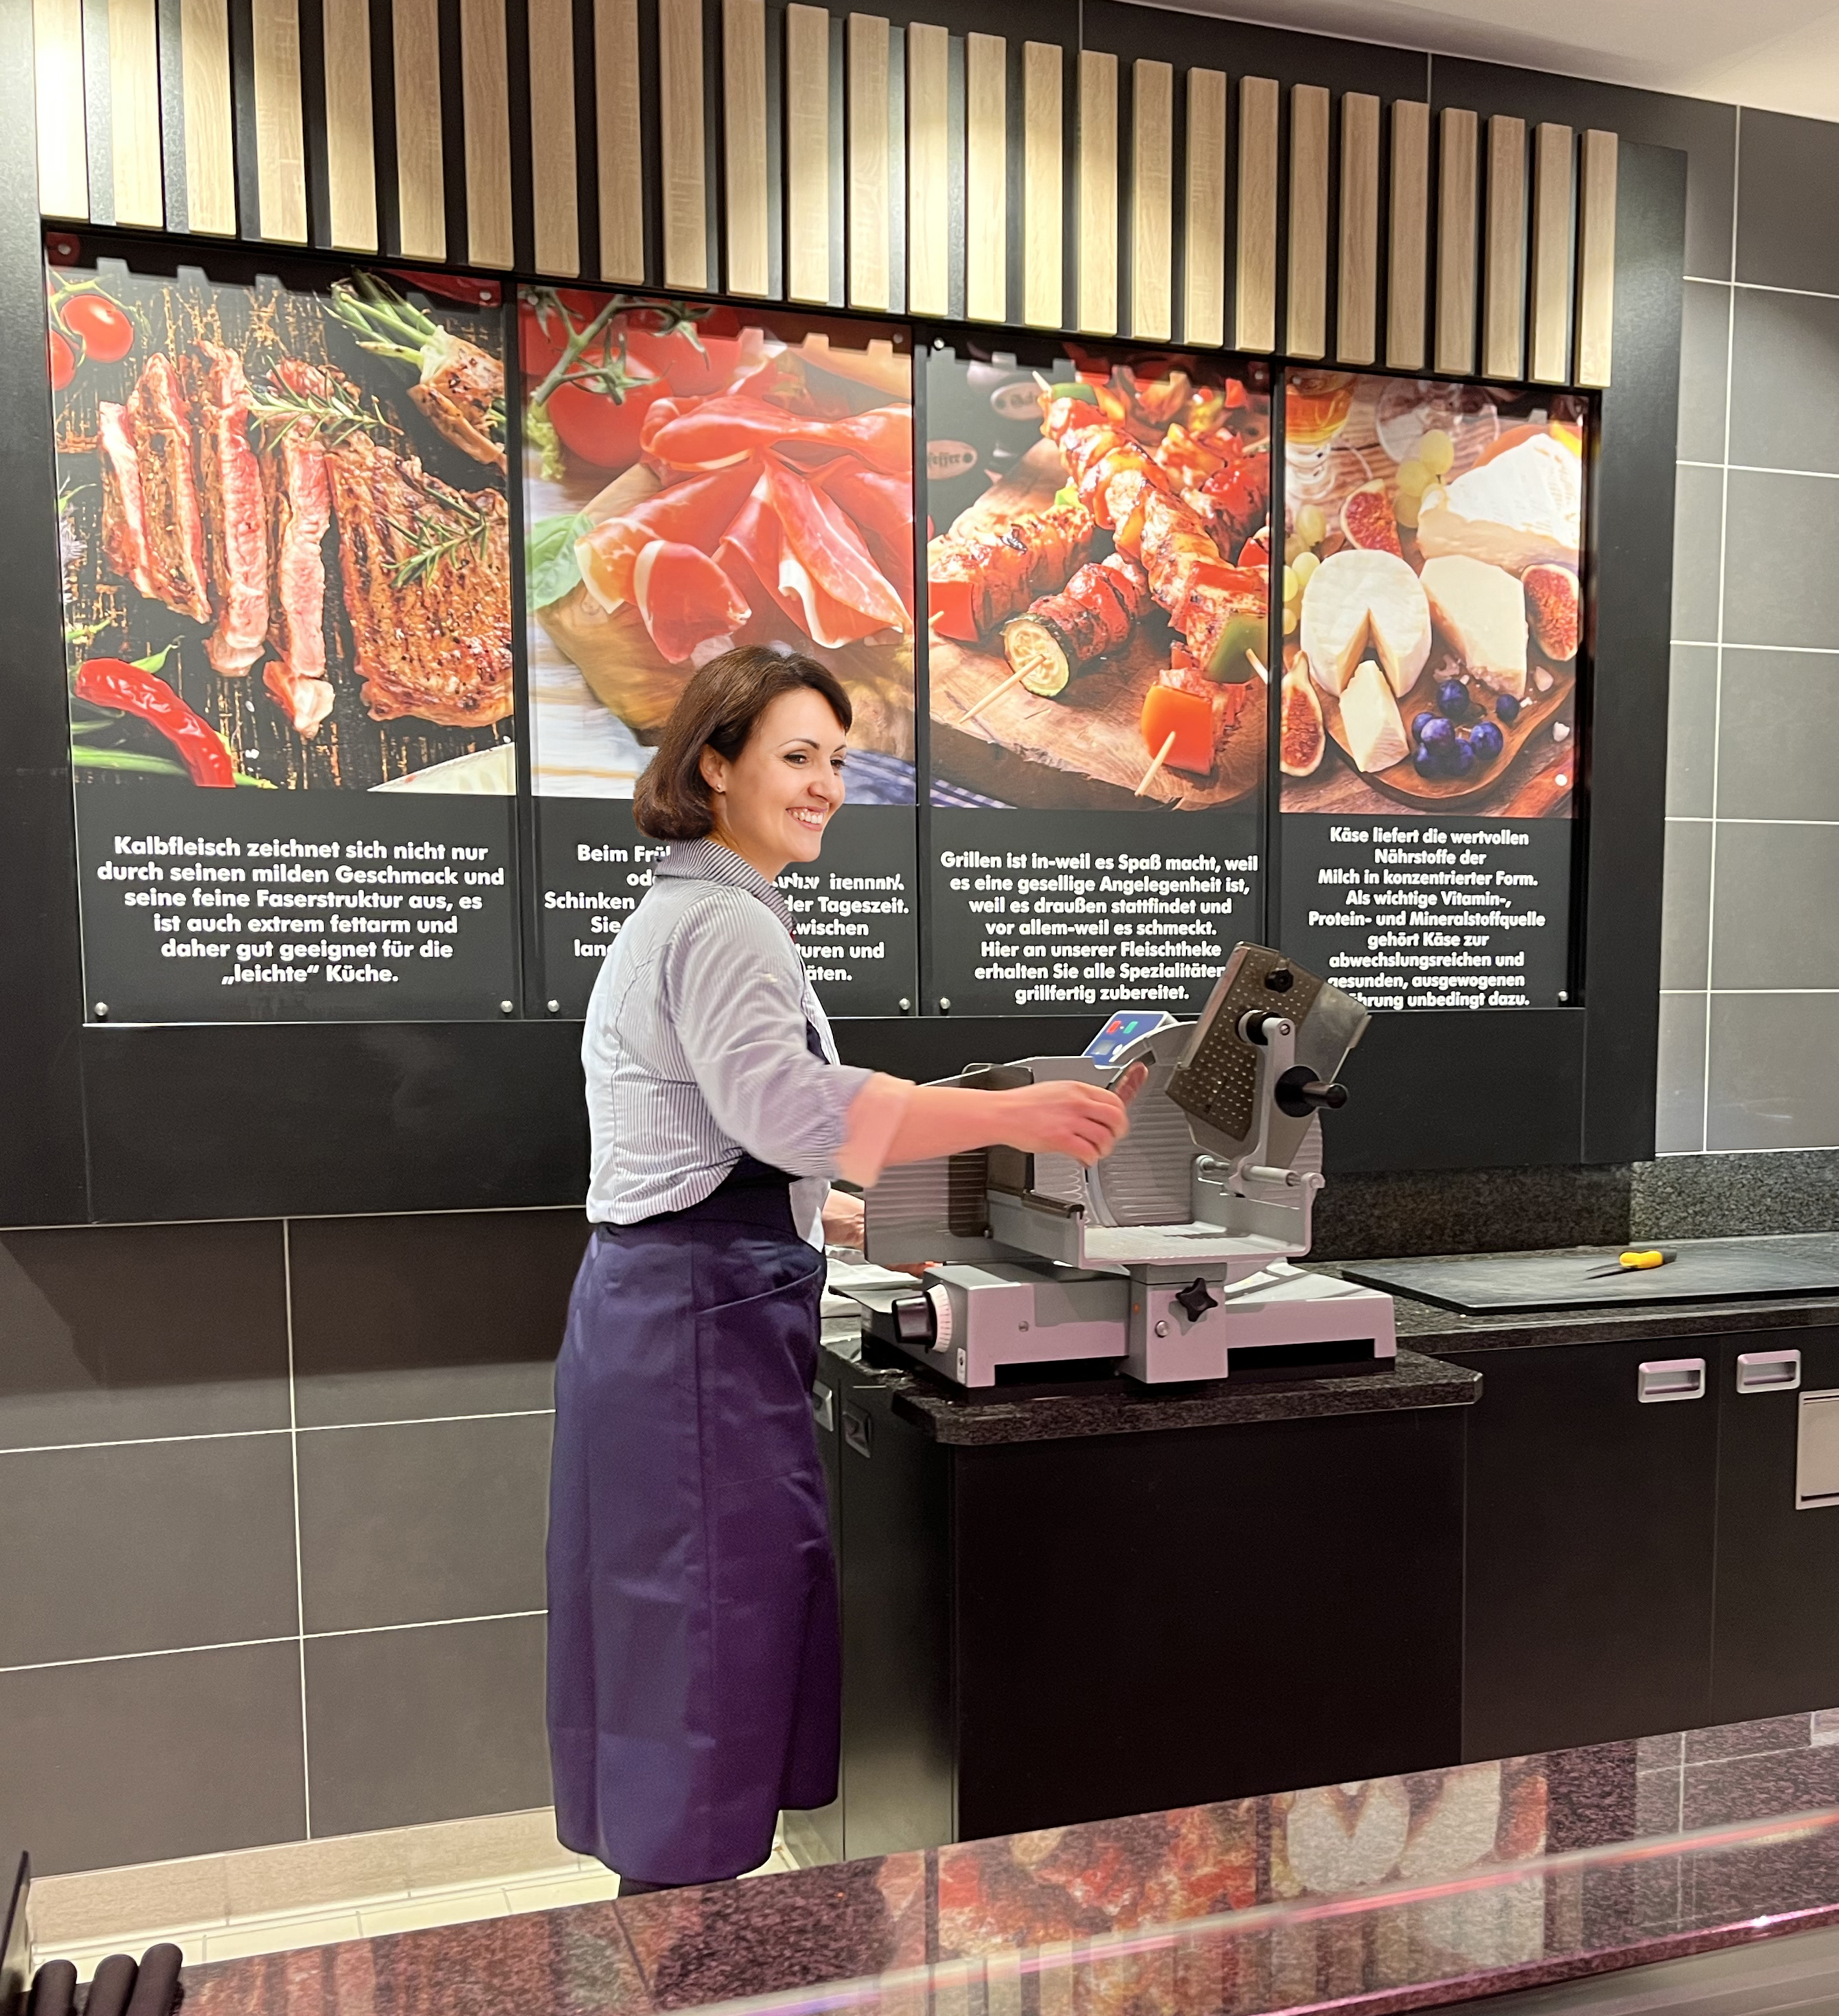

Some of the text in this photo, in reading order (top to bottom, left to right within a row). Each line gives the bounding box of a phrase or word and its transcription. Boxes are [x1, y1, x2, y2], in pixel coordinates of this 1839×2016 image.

[1331, 827, 1529, 845] Käse liefert die wertvollen
[115, 836, 488, 860] Kalbfleisch zeichnet sich nicht nur
[578, 845, 628, 862] Beim
[1375, 849, 1487, 864] Nährstoffe der
[941, 851, 1002, 868] Grillen
[1007, 852, 1027, 869] ist
[1095, 858, 1114, 869] es
[1118, 854, 1161, 873] Spaß
[1166, 854, 1221, 873] macht,
[1224, 856, 1257, 871] weil
[98, 861, 504, 885] durch seinen milden Geschmack und
[1318, 869, 1538, 886] Milch in konzentrierter Form.
[950, 875, 1249, 895] es eine gesellige Angelegenheit ist,
[125, 888, 482, 911] seine feine Faserstruktur aus, es
[544, 891, 636, 910] Schinken
[818, 897, 909, 917] Tageszeit.
[969, 897, 1231, 914] weil es draußen stattfindet und
[1346, 890, 1370, 905] Als
[1373, 890, 1437, 908] wichtige
[154, 913, 457, 933] ist auch extrem fettarm und
[591, 915, 869, 935] Sie wischen
[985, 923, 1015, 935] vor
[1114, 924, 1132, 935] es
[1136, 919, 1216, 935] schmeckt.
[1376, 910, 1406, 926] und
[1409, 910, 1545, 929] Mineralstoffquelle
[161, 938, 453, 961] daher gut geeignet für die
[981, 941, 1222, 957] Hier an unserer Fleischtheke
[1368, 931, 1489, 950] gehört Käse zur
[849, 942, 884, 958] und
[1329, 952, 1524, 970] abwechslungsreichen und
[326, 964, 398, 982] Küche.
[974, 963, 1048, 979] erhalten
[1053, 963, 1079, 978] Sie
[1084, 963, 1115, 978] alle
[1412, 976, 1524, 990] ausgewogenen
[1015, 984, 1189, 1005] grillfertig zubereitet.
[1408, 992, 1485, 1009] unbedingt
[1488, 991, 1529, 1005] dazu.
